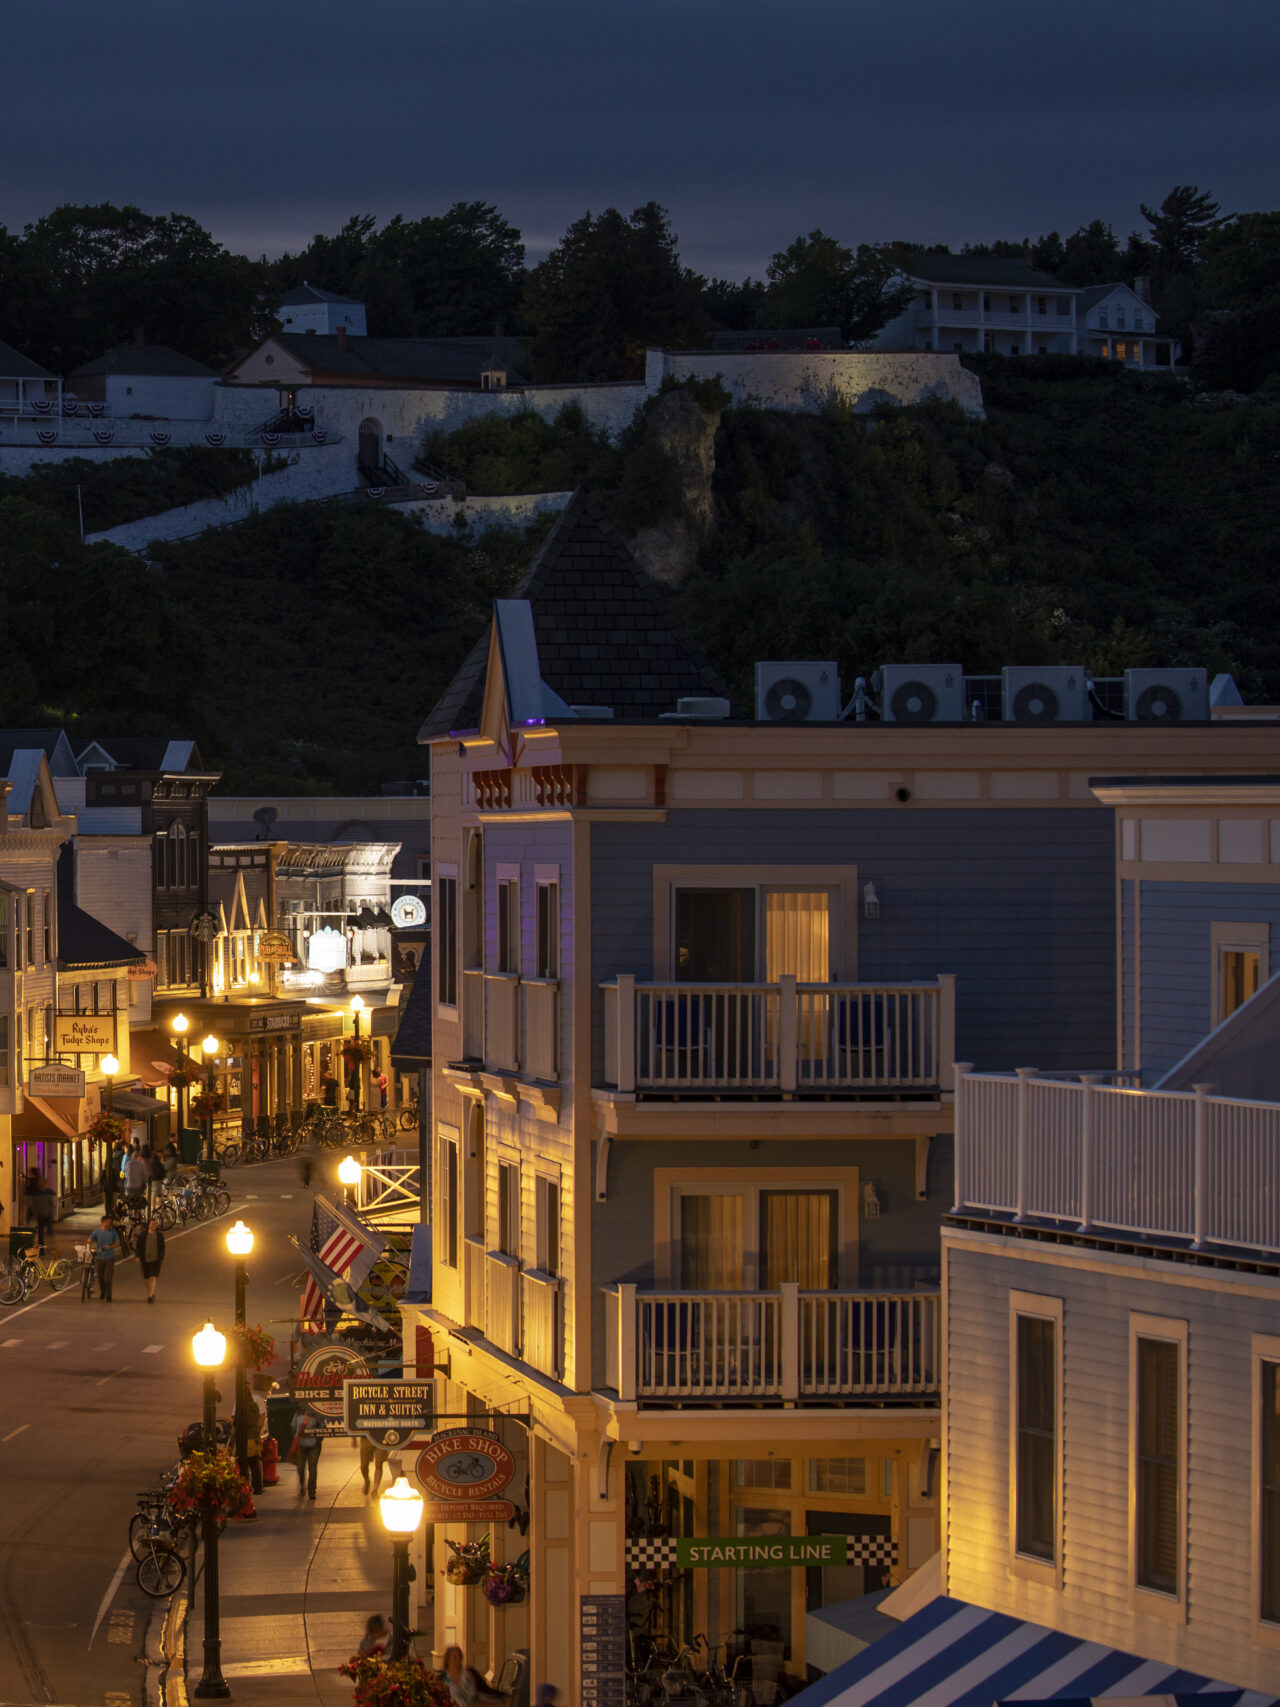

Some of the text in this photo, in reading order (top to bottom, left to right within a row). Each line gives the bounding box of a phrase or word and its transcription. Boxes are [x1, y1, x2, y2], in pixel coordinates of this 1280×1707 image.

[138, 968, 154, 976] Shops
[267, 1016, 290, 1028] STARBUCKS
[72, 1022, 98, 1036] Ryba's
[60, 1034, 110, 1046] Fudge Shops
[34, 1073, 80, 1084] ARTISTS MARKET
[295, 1390, 330, 1398] BIKE
[352, 1386, 388, 1400] BICYCLE
[394, 1386, 429, 1400] STREET
[359, 1404, 422, 1416] INN & SUITES
[433, 1428, 498, 1441] MACKINAC ISLAND
[424, 1438, 508, 1464] BIKE SHOP
[426, 1473, 506, 1496] BICYCLE RENTALS
[690, 1545, 832, 1562] STARTING LINE
